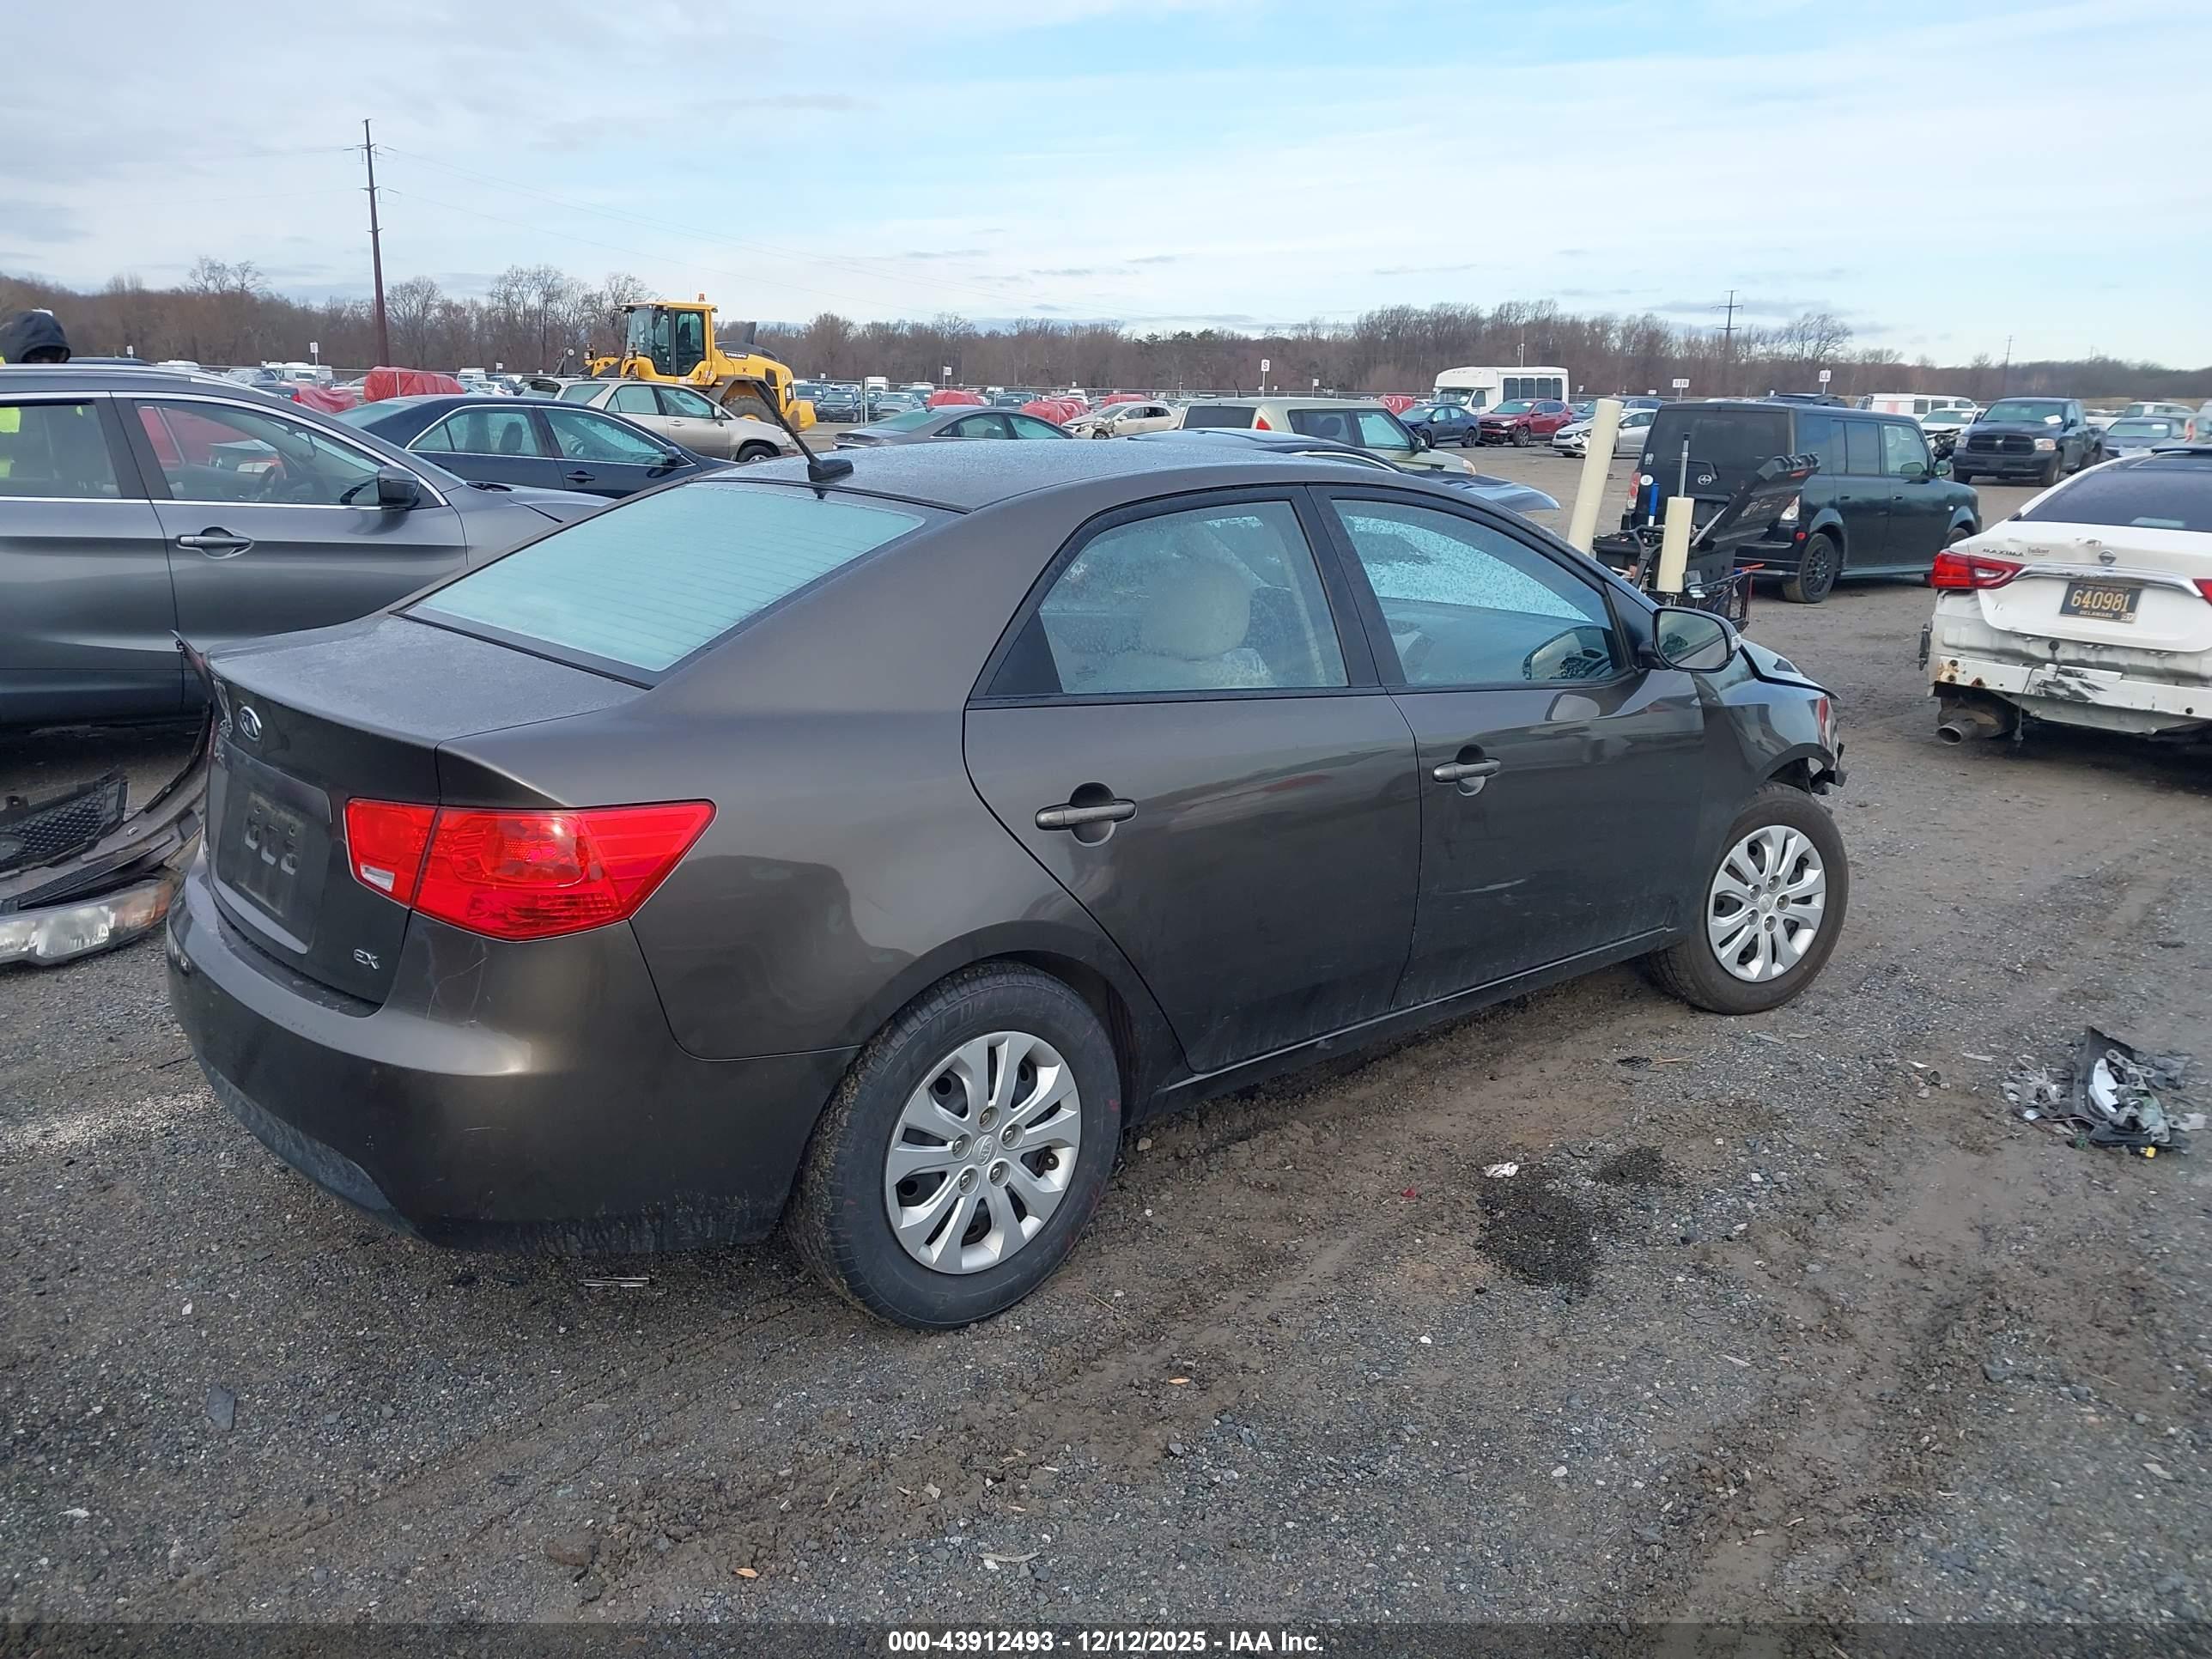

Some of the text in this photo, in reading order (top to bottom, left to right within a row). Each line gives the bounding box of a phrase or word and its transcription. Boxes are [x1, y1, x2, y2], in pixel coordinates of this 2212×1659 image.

[1262, 361, 1269, 370] S
[1983, 548, 2024, 557] MAXIMA
[2070, 589, 2130, 612] 640981
[2079, 610, 2114, 618] DELAWARE
[354, 949, 380, 969] EX
